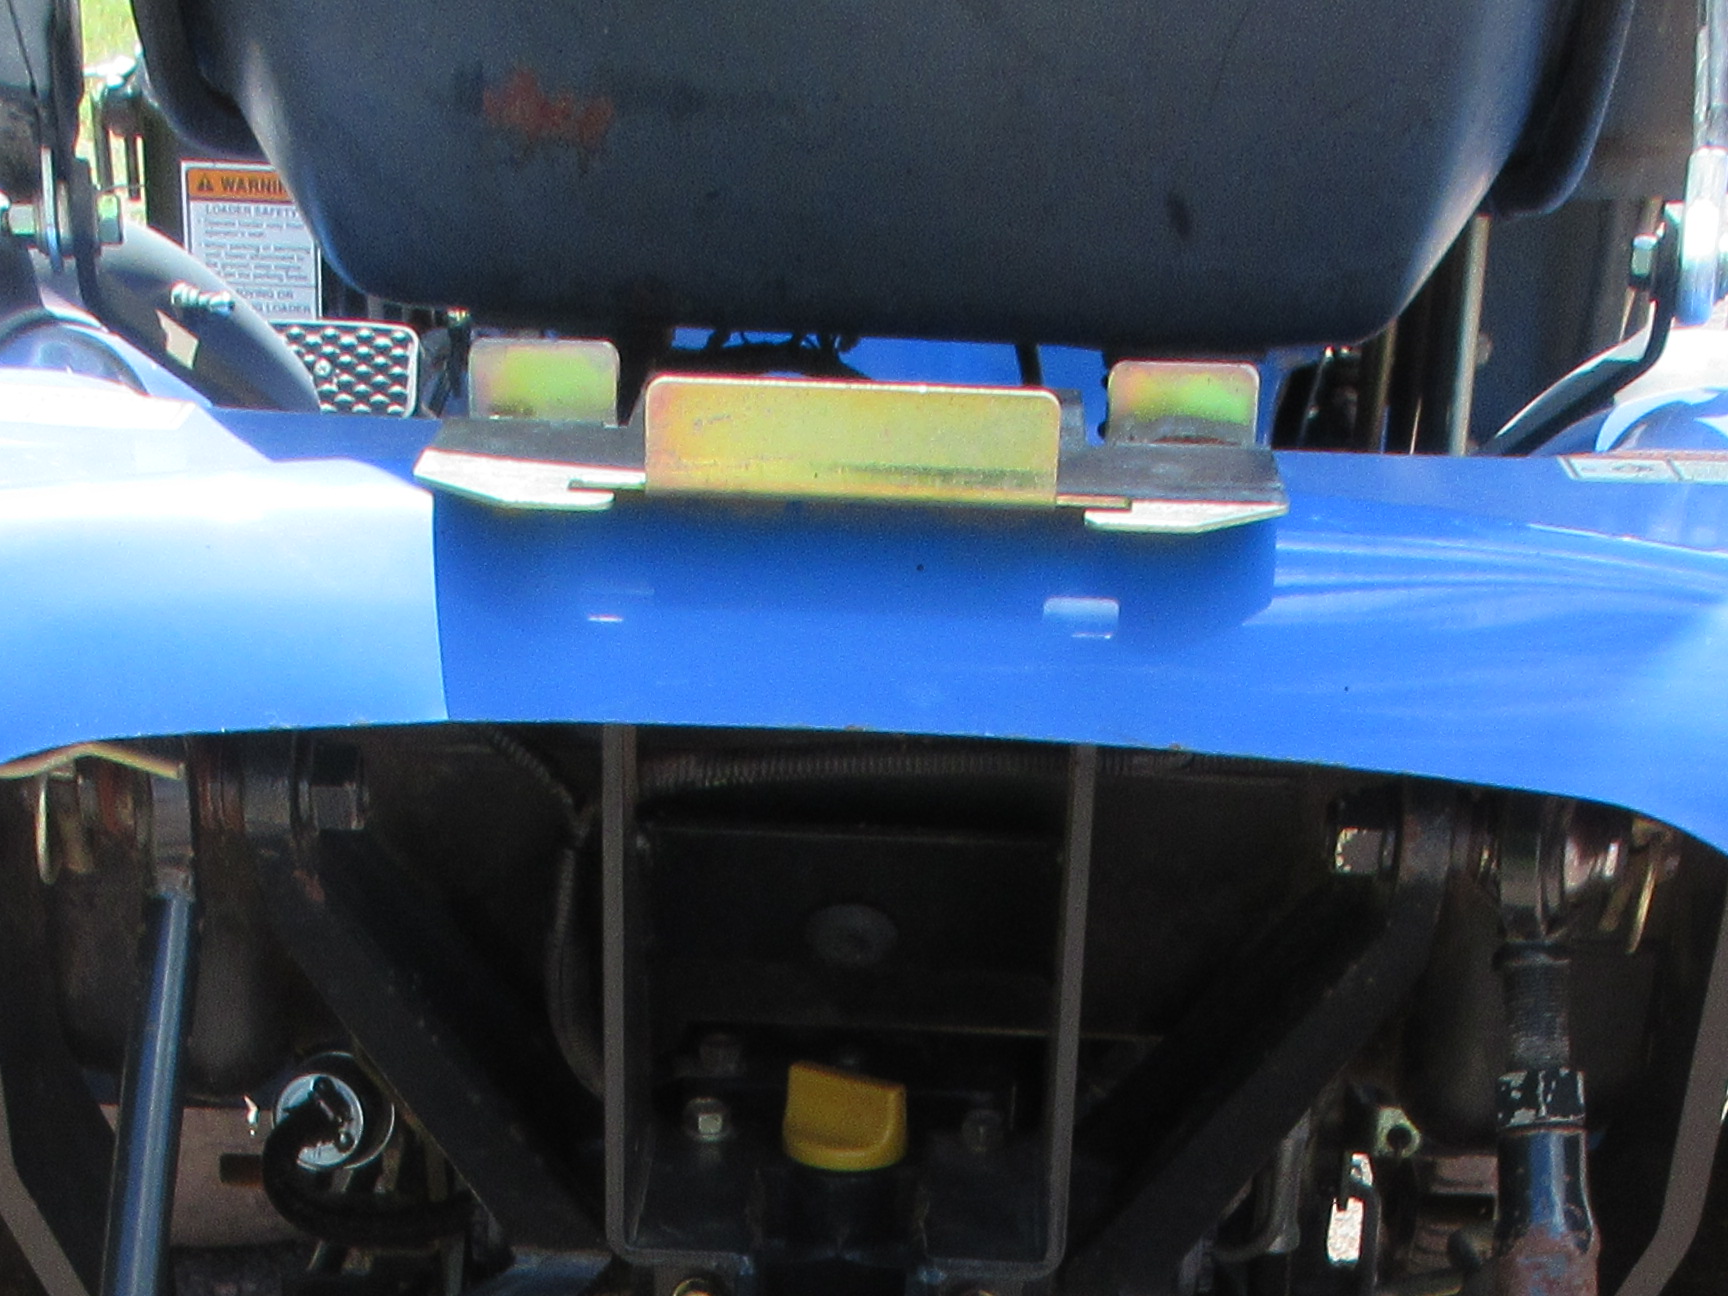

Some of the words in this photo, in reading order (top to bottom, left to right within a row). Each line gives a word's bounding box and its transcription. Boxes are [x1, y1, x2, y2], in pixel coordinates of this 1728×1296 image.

[222, 176, 286, 194] WARNI
[205, 204, 252, 215] LOADER
[255, 206, 297, 218] SAFETY
